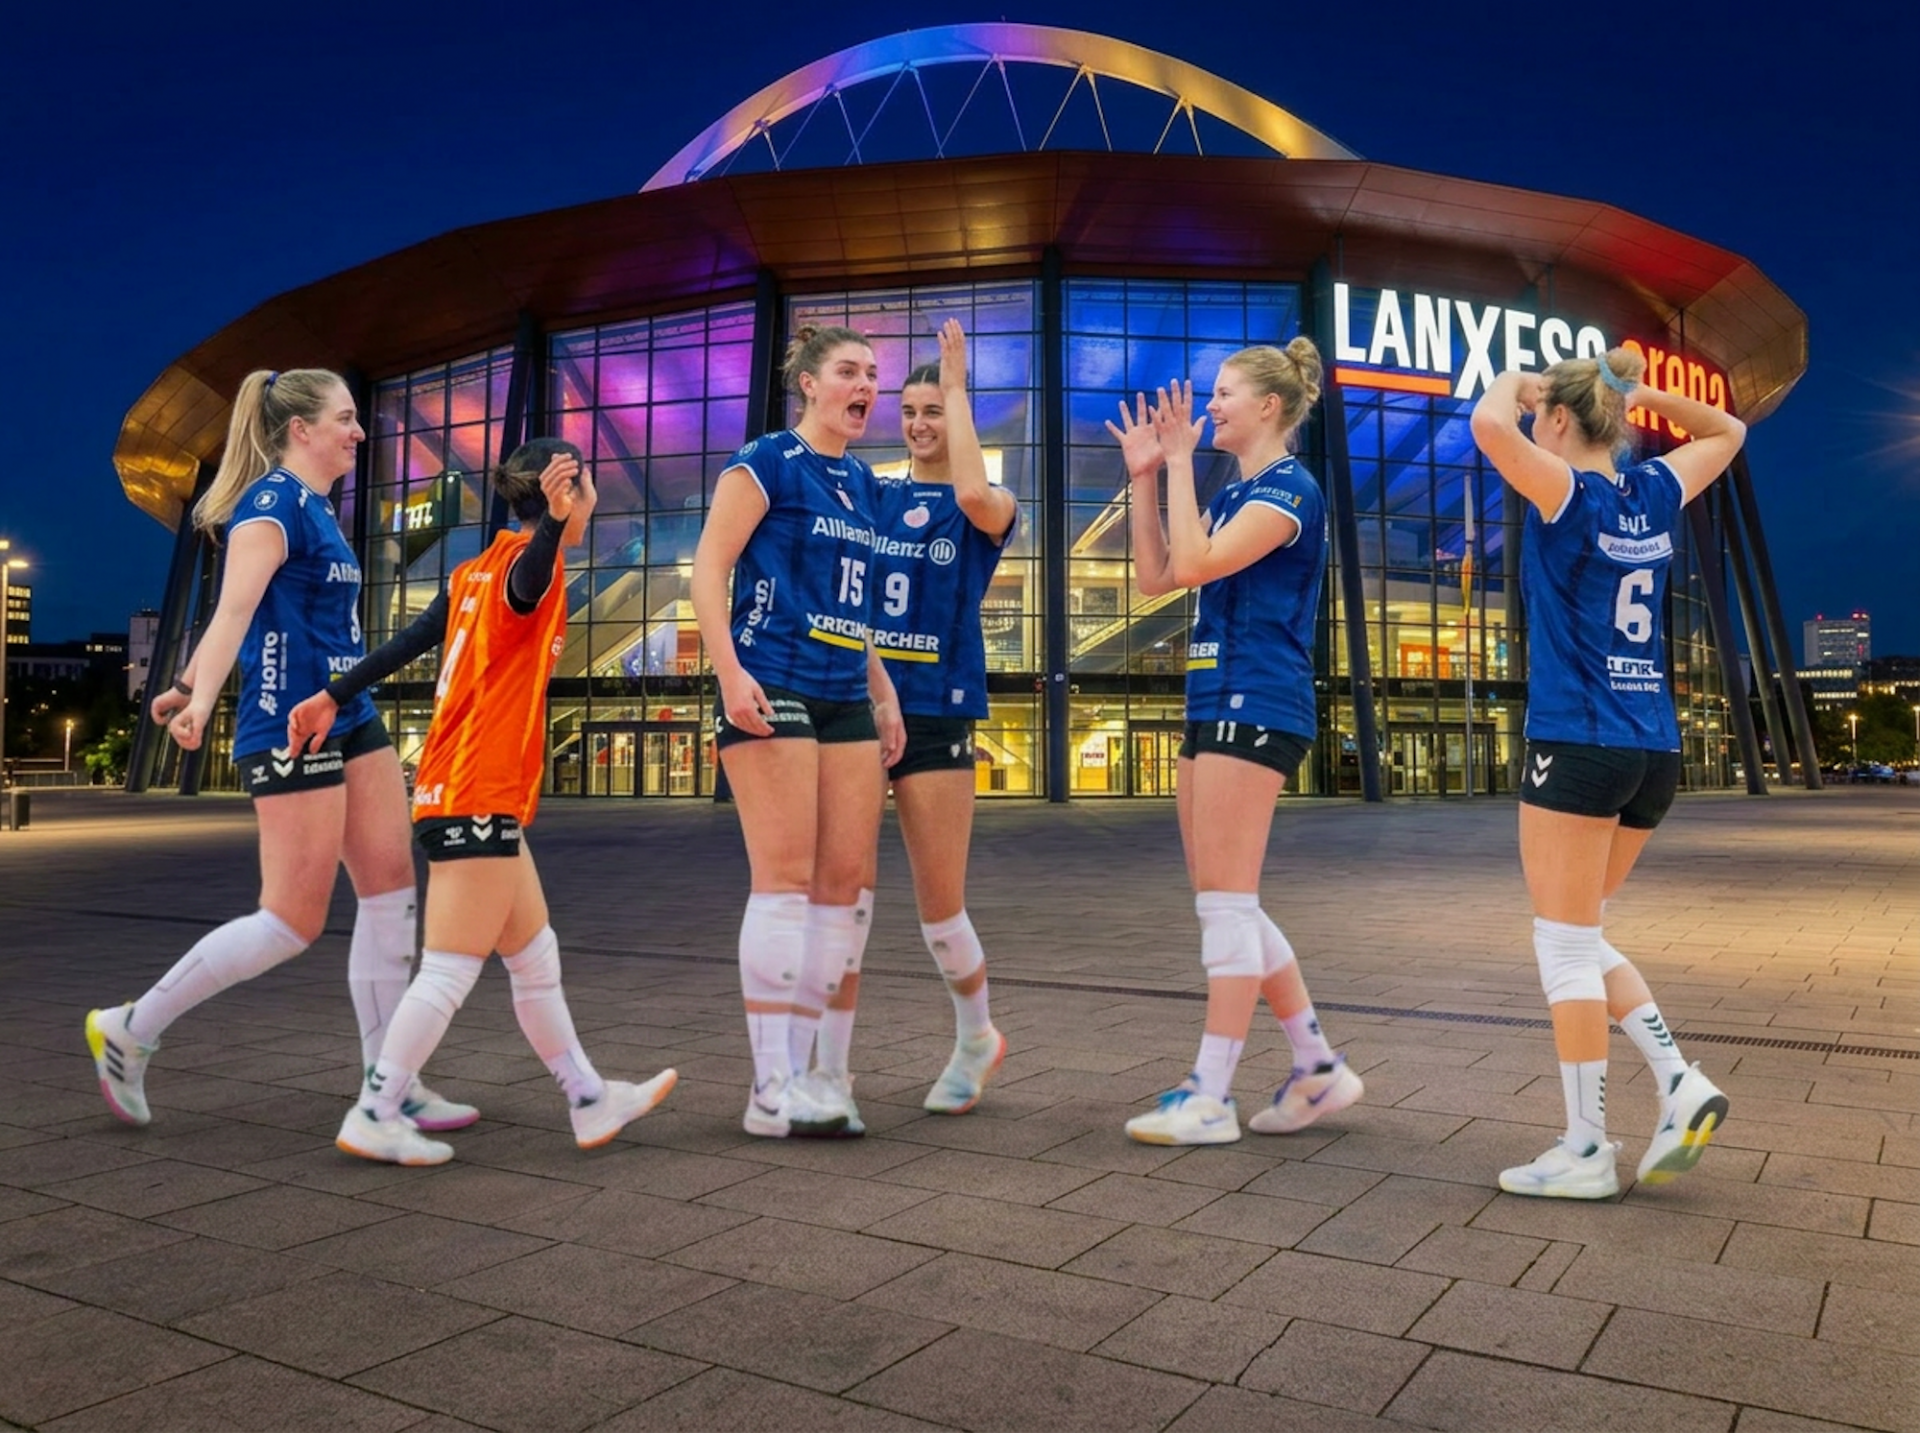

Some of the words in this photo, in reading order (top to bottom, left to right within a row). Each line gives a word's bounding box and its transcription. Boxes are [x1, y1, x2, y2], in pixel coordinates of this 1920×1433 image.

[838, 556, 866, 607] 15
[884, 572, 910, 617] 9
[1615, 568, 1654, 643] 6
